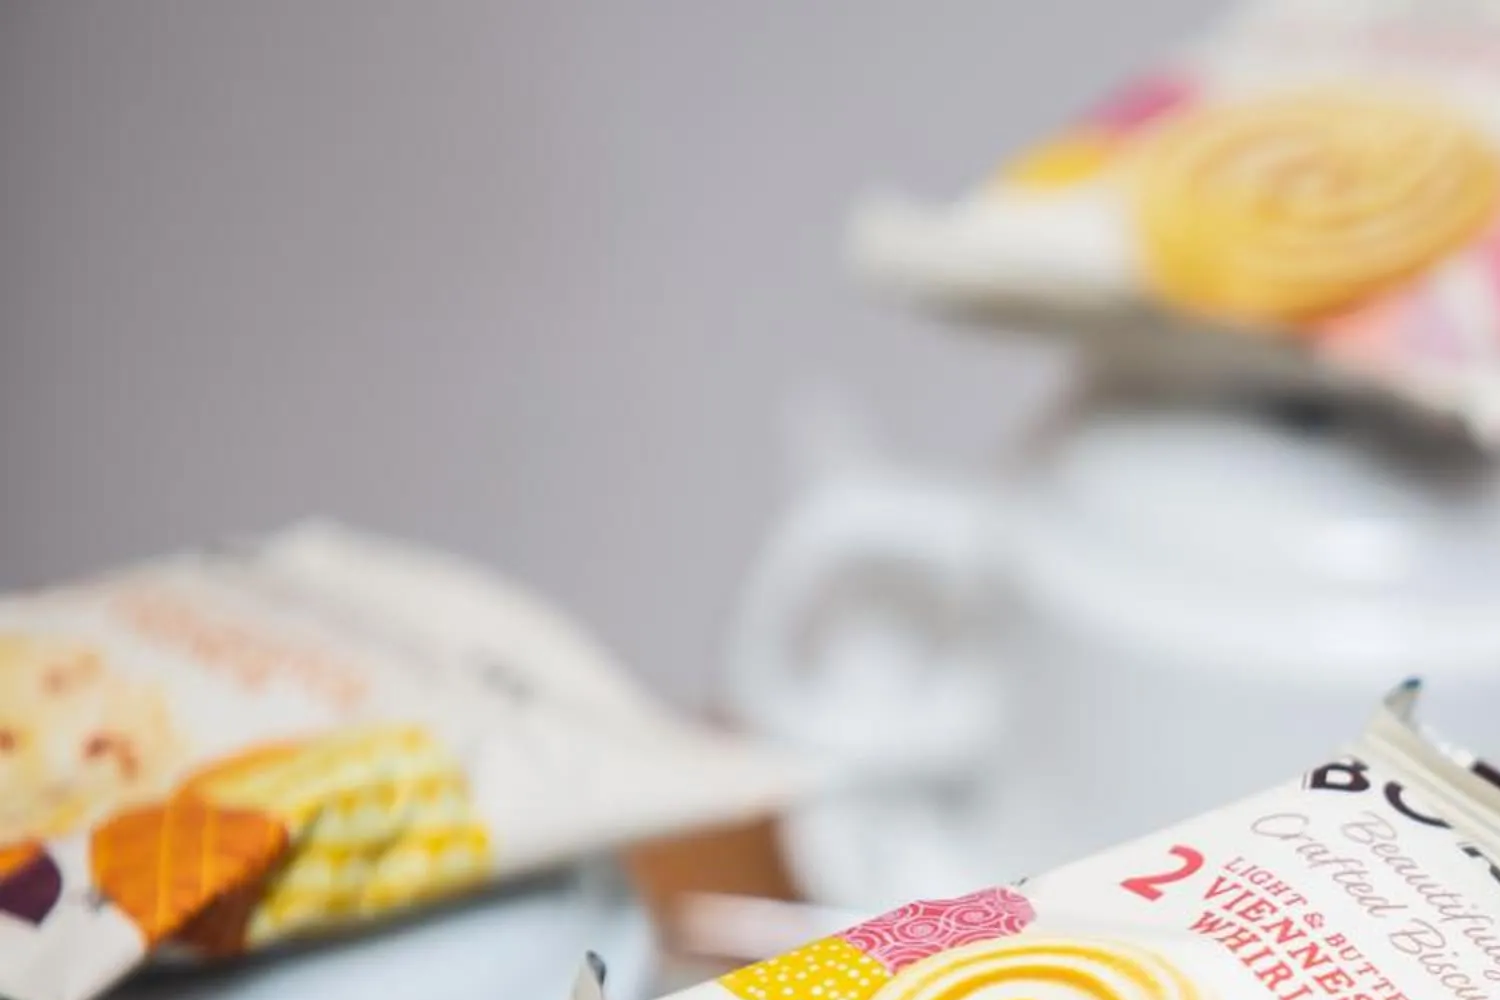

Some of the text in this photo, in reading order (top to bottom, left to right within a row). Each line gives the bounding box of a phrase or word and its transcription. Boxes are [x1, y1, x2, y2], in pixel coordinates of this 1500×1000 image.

[1119, 844, 1205, 901] 2
[1223, 856, 1308, 908] LIGHT
[1303, 911, 1326, 930] &
[1250, 812, 1408, 919] Crafted
